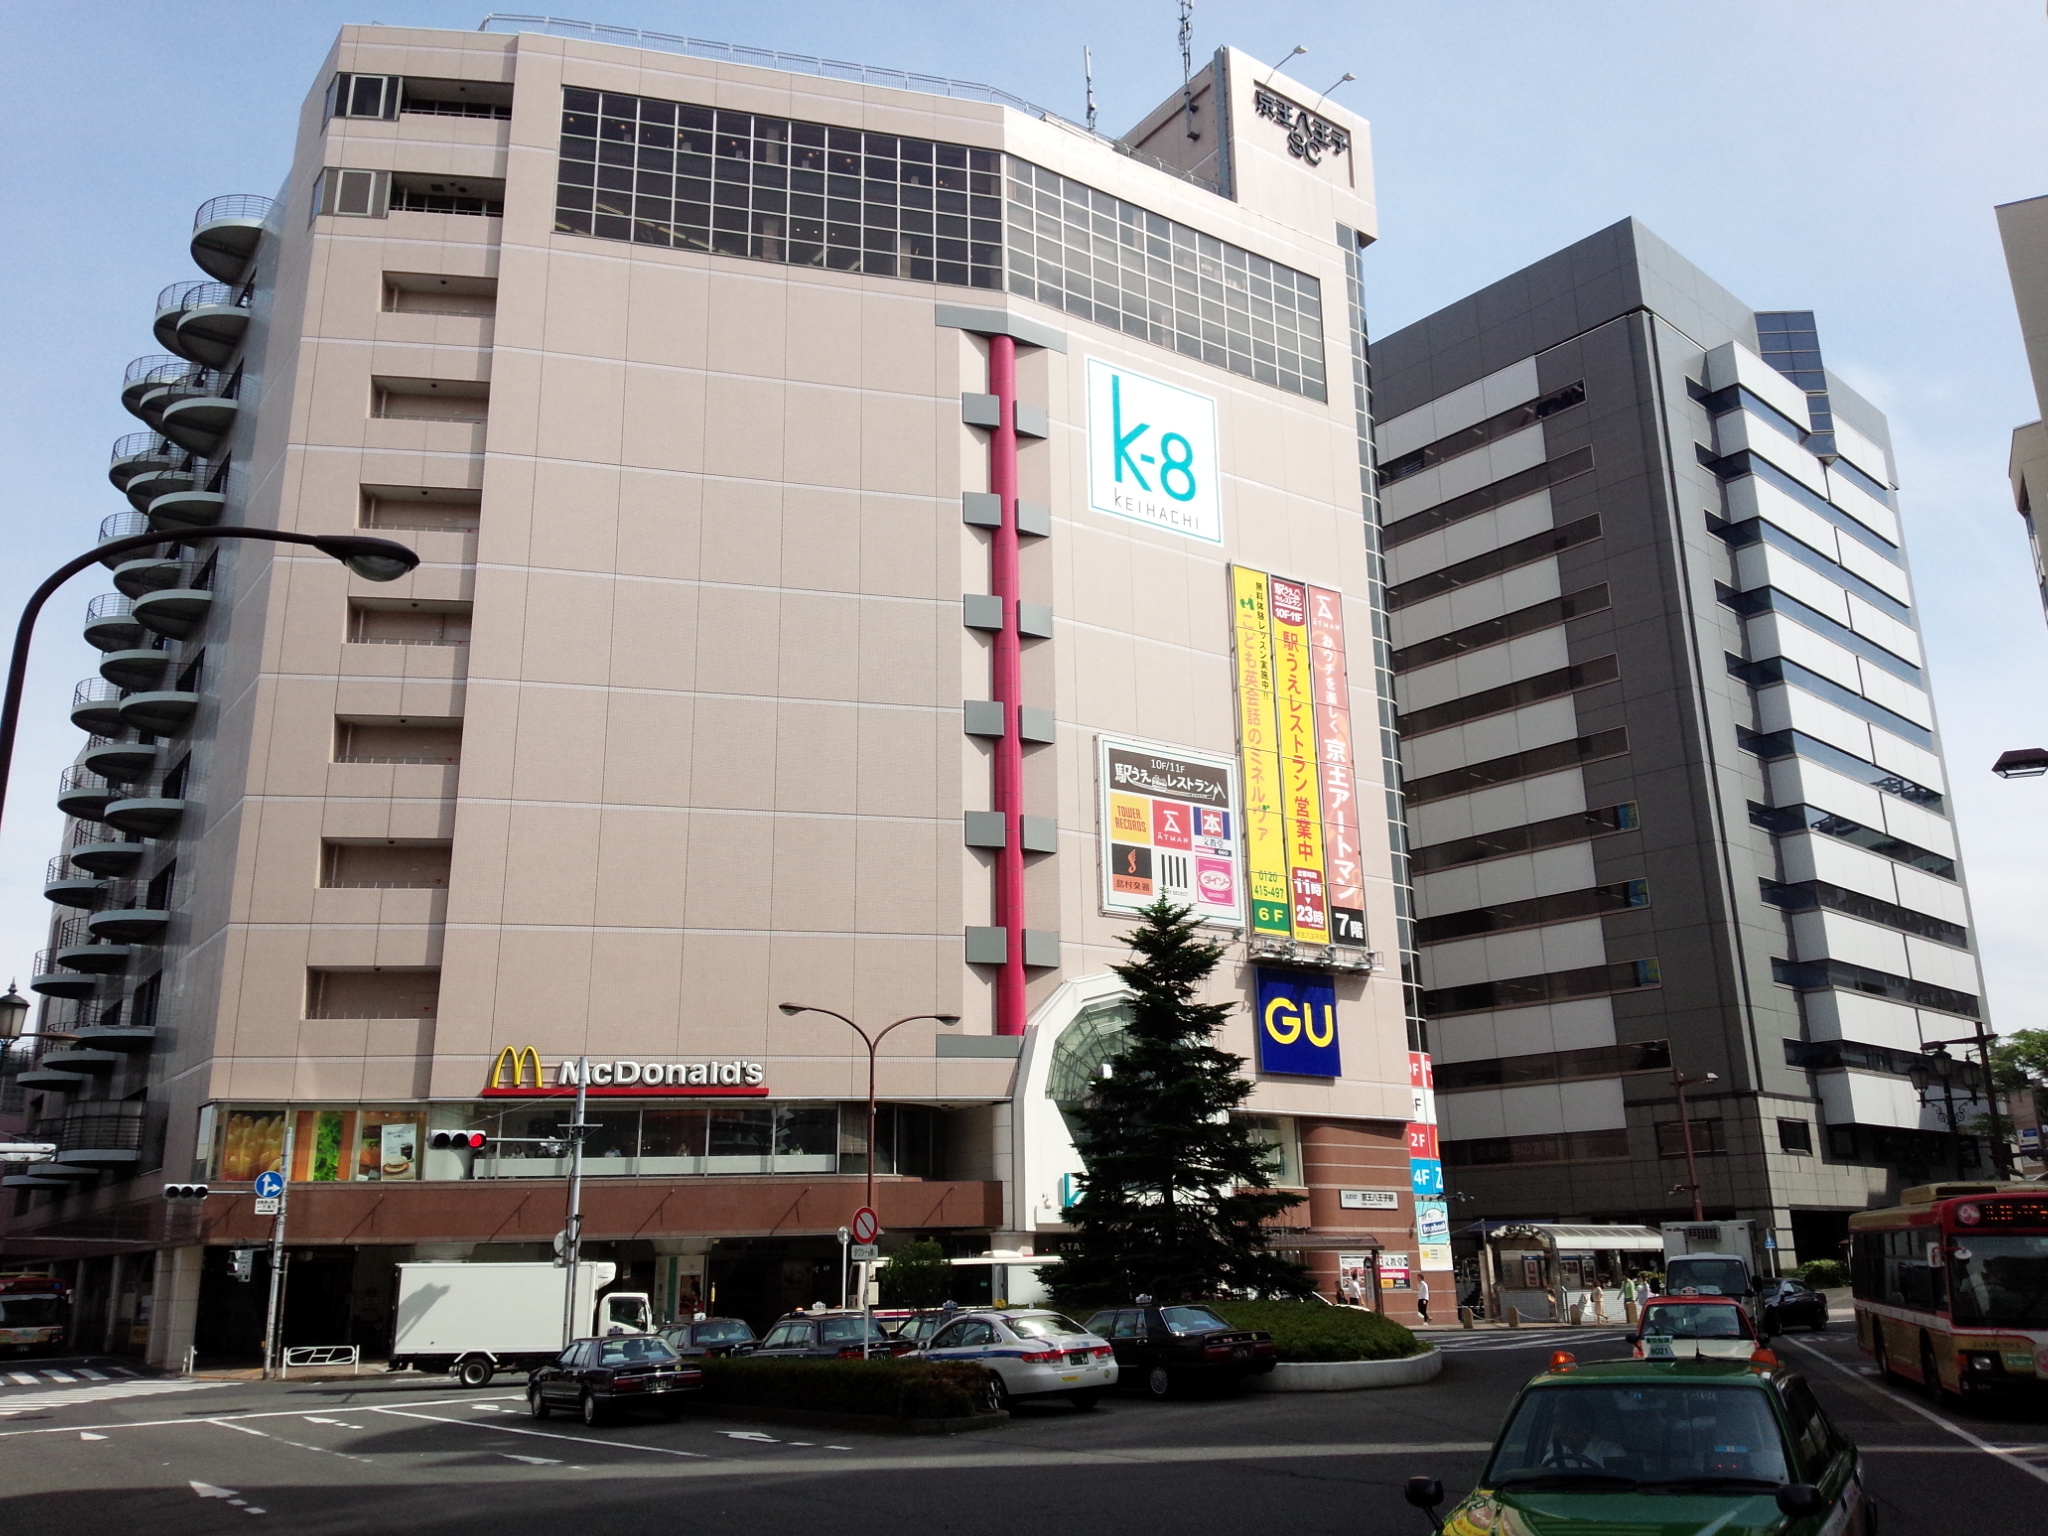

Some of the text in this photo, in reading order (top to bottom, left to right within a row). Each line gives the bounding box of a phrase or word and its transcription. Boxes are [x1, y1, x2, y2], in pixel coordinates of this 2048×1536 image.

[1255, 89, 1350, 154] 京王八王子
[1287, 131, 1322, 166] SC
[1283, 631, 1313, 862] 駅うえレストラン営業中
[1117, 805, 1142, 820] TOWER
[1324, 738, 1357, 900] 京王アートマン
[1115, 817, 1147, 832] RECORDS
[1203, 814, 1221, 833] 本
[1115, 879, 1150, 892] 島村楽器
[1203, 876, 1230, 886] ダイソー
[1258, 870, 1278, 882] 0120
[1254, 885, 1284, 899] 415-497
[1294, 878, 1322, 897] 11時
[1296, 904, 1324, 925] 23時
[1335, 913, 1363, 939] 7階
[1264, 997, 1334, 1048] GU
[558, 1061, 764, 1086] McDonald's
[1411, 1132, 1426, 1148] 2F
[1413, 1168, 1430, 1186] 4F
